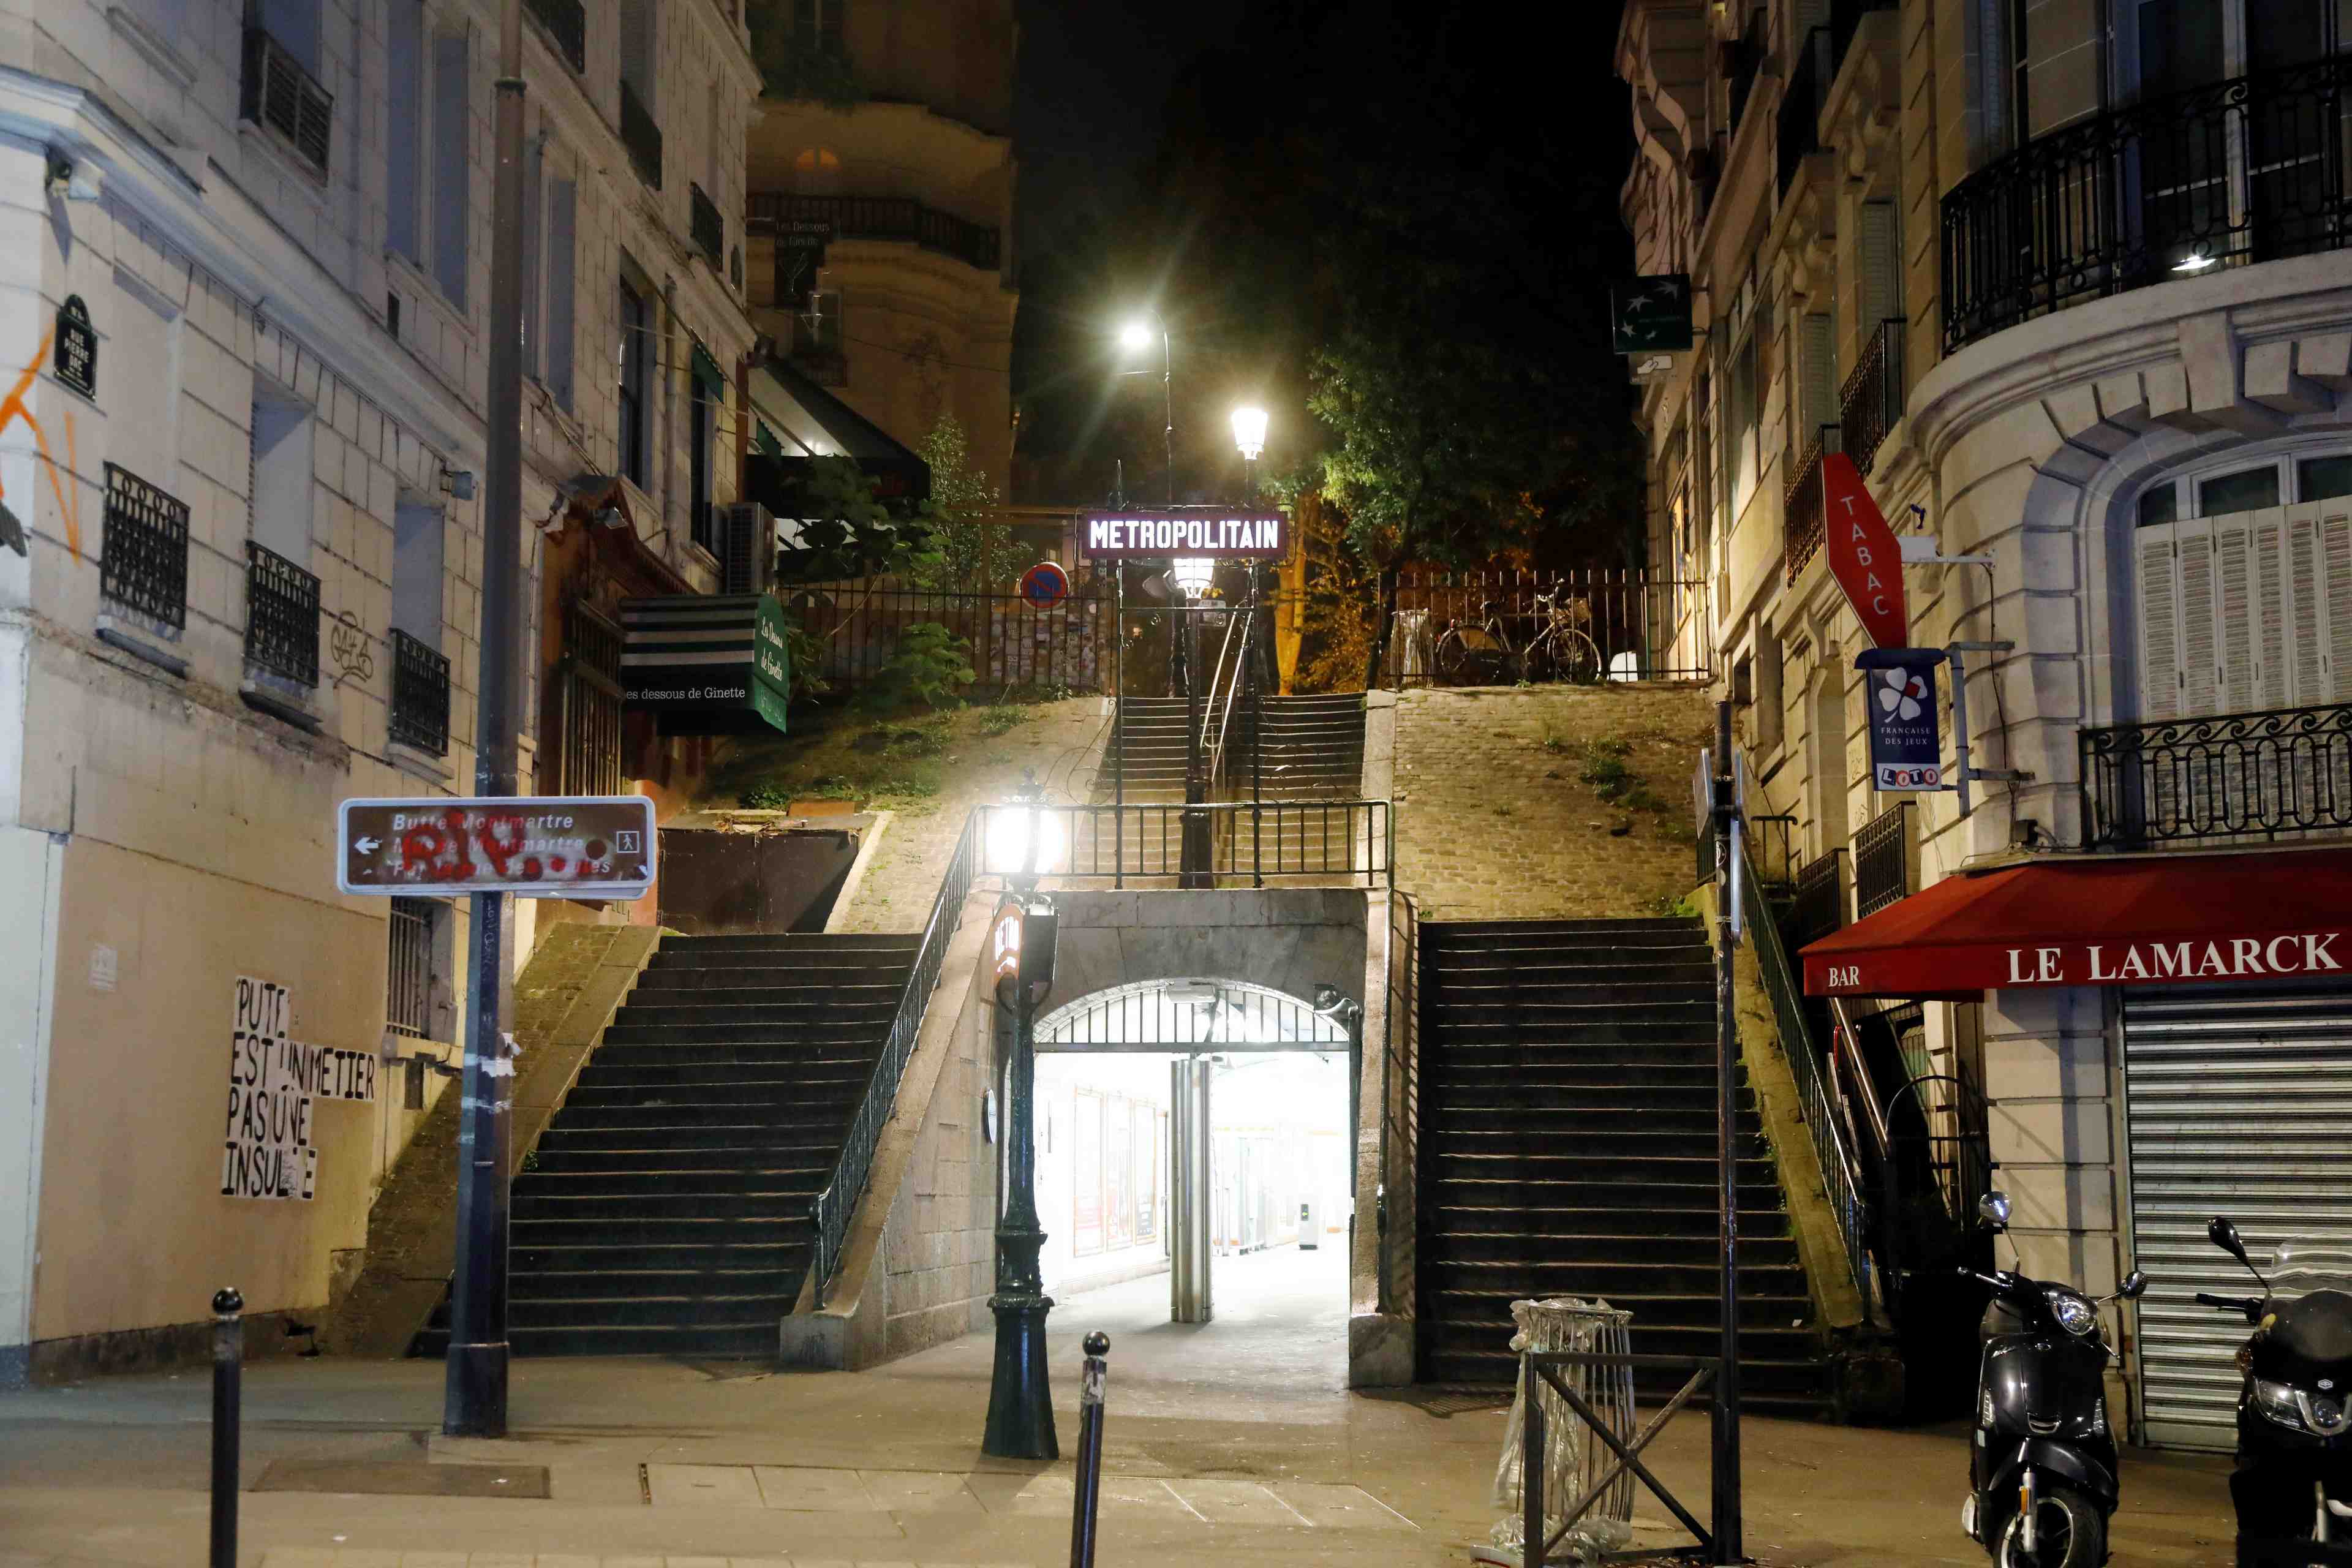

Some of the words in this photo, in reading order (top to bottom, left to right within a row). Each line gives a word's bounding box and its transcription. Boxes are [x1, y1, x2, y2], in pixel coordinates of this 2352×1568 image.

[1090, 521, 1279, 549] METROPOLITAIN
[1840, 496, 1888, 616] TABAC
[627, 690, 638, 699] es
[641, 688, 685, 699] dessous
[688, 688, 701, 699] de
[704, 687, 745, 698] Ginette
[1881, 767, 1939, 788] LOTO
[1828, 966, 1860, 987] BAR
[2007, 948, 2064, 983] LE
[2086, 933, 2342, 980] LAMARCK
[231, 1031, 274, 1088] EST
[309, 1047, 375, 1099] METIER
[227, 1087, 268, 1143] PAS
[273, 1093, 309, 1147] UNE
[221, 1141, 316, 1199] INSULE
